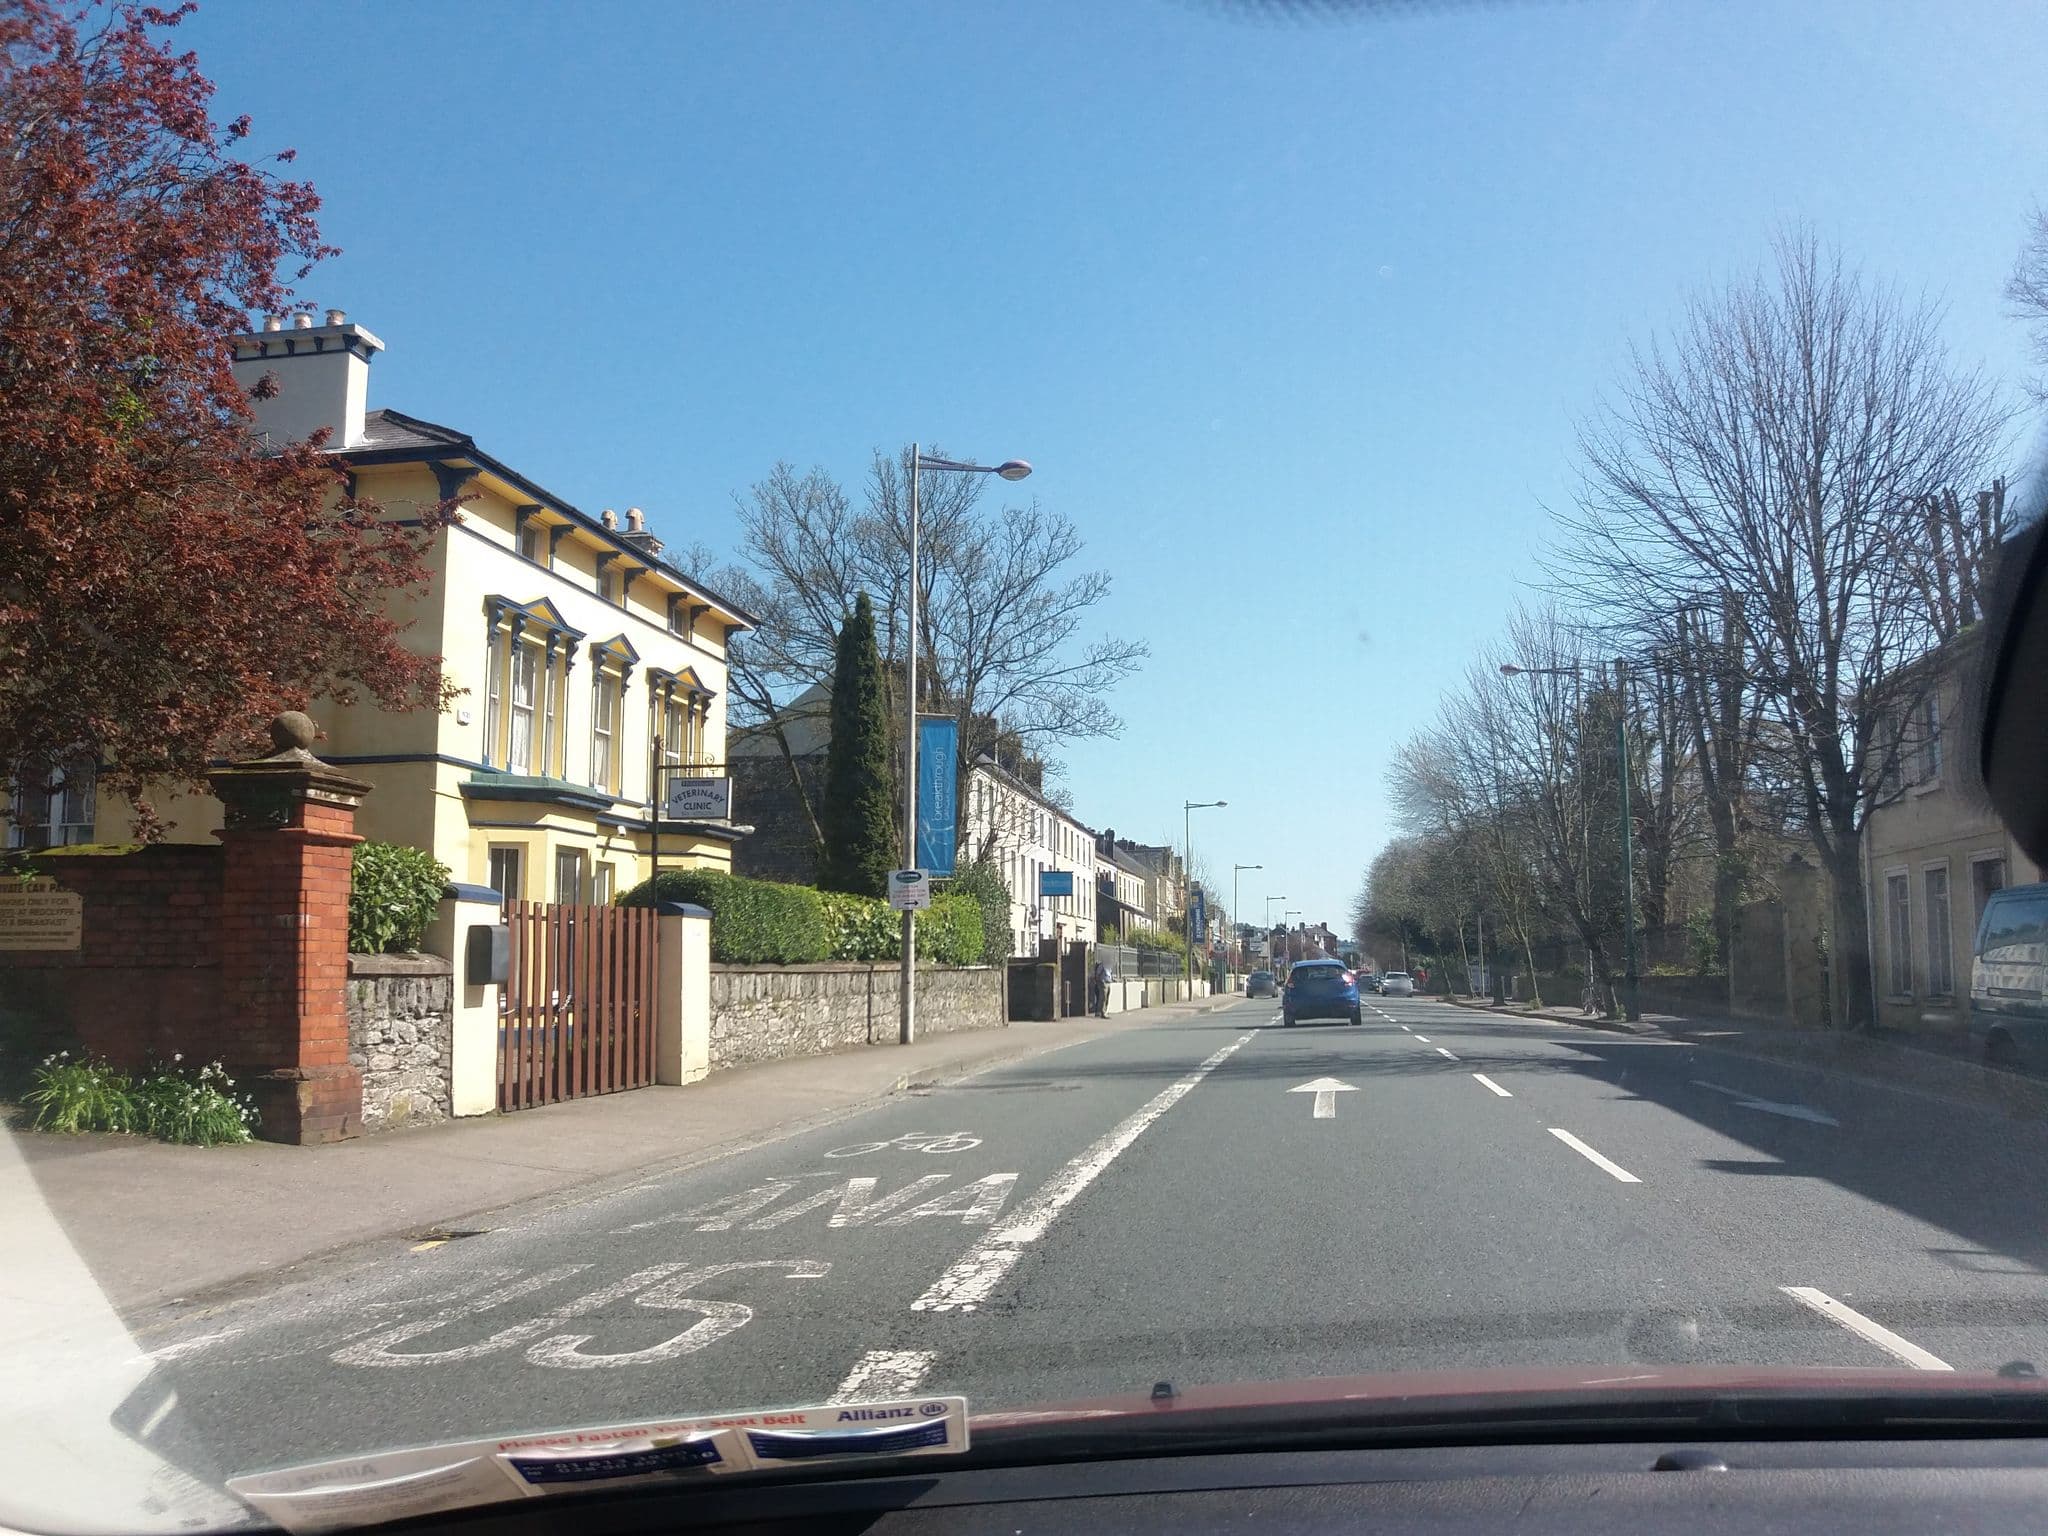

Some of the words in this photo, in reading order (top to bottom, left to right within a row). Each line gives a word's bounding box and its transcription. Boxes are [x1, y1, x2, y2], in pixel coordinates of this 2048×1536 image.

[932, 746, 947, 821] breakthrough
[672, 788, 725, 803] VETERINARY
[683, 802, 712, 810] CLINIC
[837, 1406, 914, 1422] Allianz
[497, 1436, 571, 1451] Please
[576, 1428, 648, 1444] Fasten
[711, 1416, 757, 1429] Seat
[763, 1414, 806, 1425] Belt
